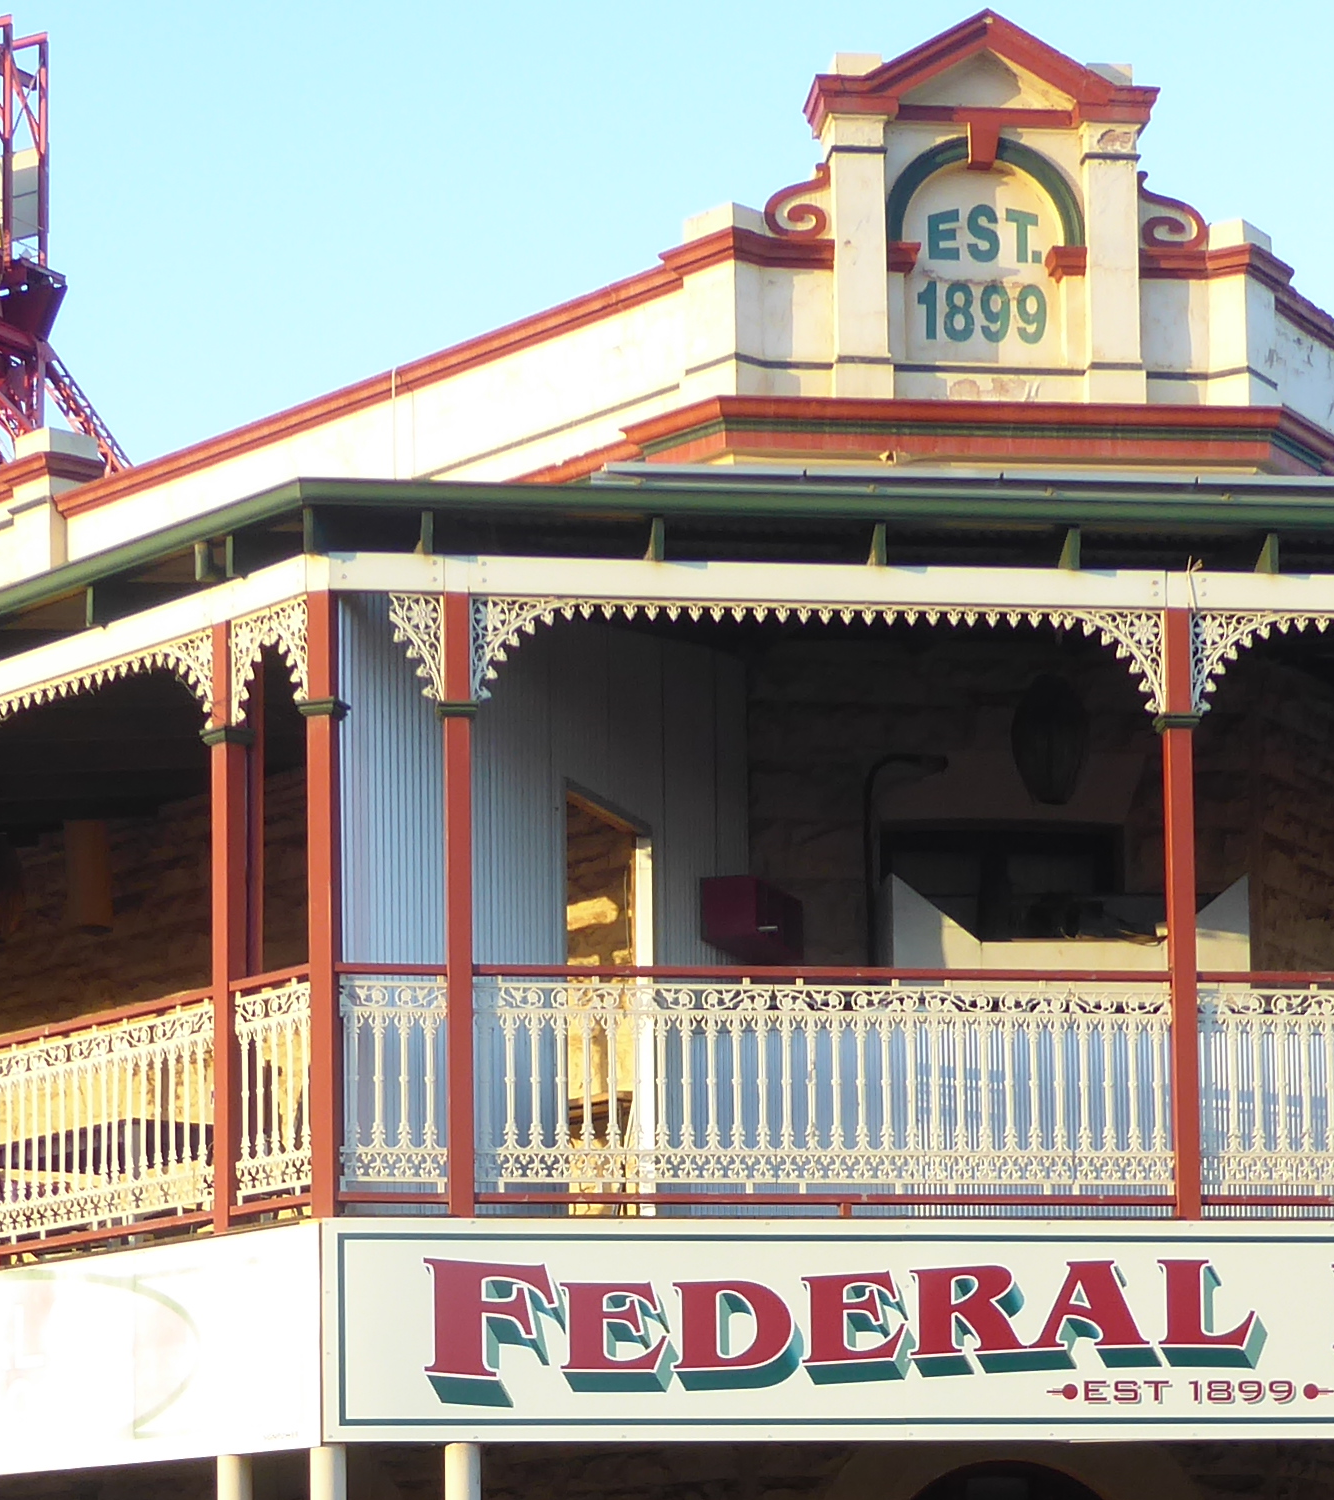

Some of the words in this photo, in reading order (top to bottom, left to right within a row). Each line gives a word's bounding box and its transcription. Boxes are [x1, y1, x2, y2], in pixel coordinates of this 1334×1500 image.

[927, 204, 1042, 263] EST.
[917, 280, 1047, 344] 1899
[423, 1257, 1268, 1407] FEDERAL
[1082, 1380, 1166, 1405] EST
[1188, 1379, 1297, 1405] 1899
